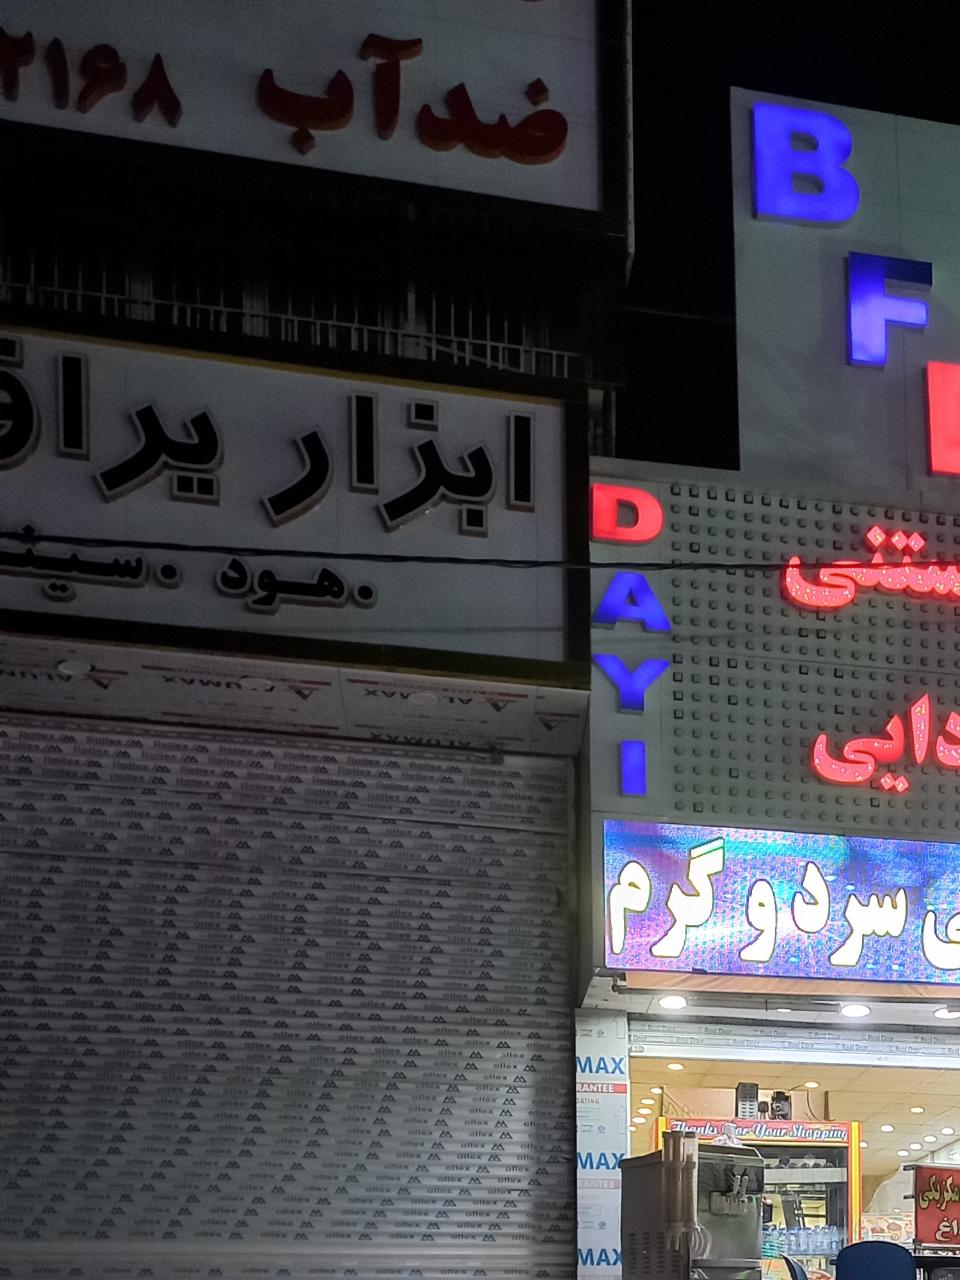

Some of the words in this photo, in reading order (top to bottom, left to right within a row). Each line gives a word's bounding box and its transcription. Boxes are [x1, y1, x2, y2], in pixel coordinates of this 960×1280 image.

[258, 33, 423, 155] آب
[417, 77, 568, 164] ضد
[262, 392, 536, 538] ابزار
[0, 524, 148, 602] سین
[217, 556, 348, 612] هود
[608, 837, 725, 959] گرم
[740, 878, 778, 963] و
[791, 860, 908, 967] سرد
[753, 1123, 787, 1138] Your
[789, 1123, 848, 1141] Shopping
